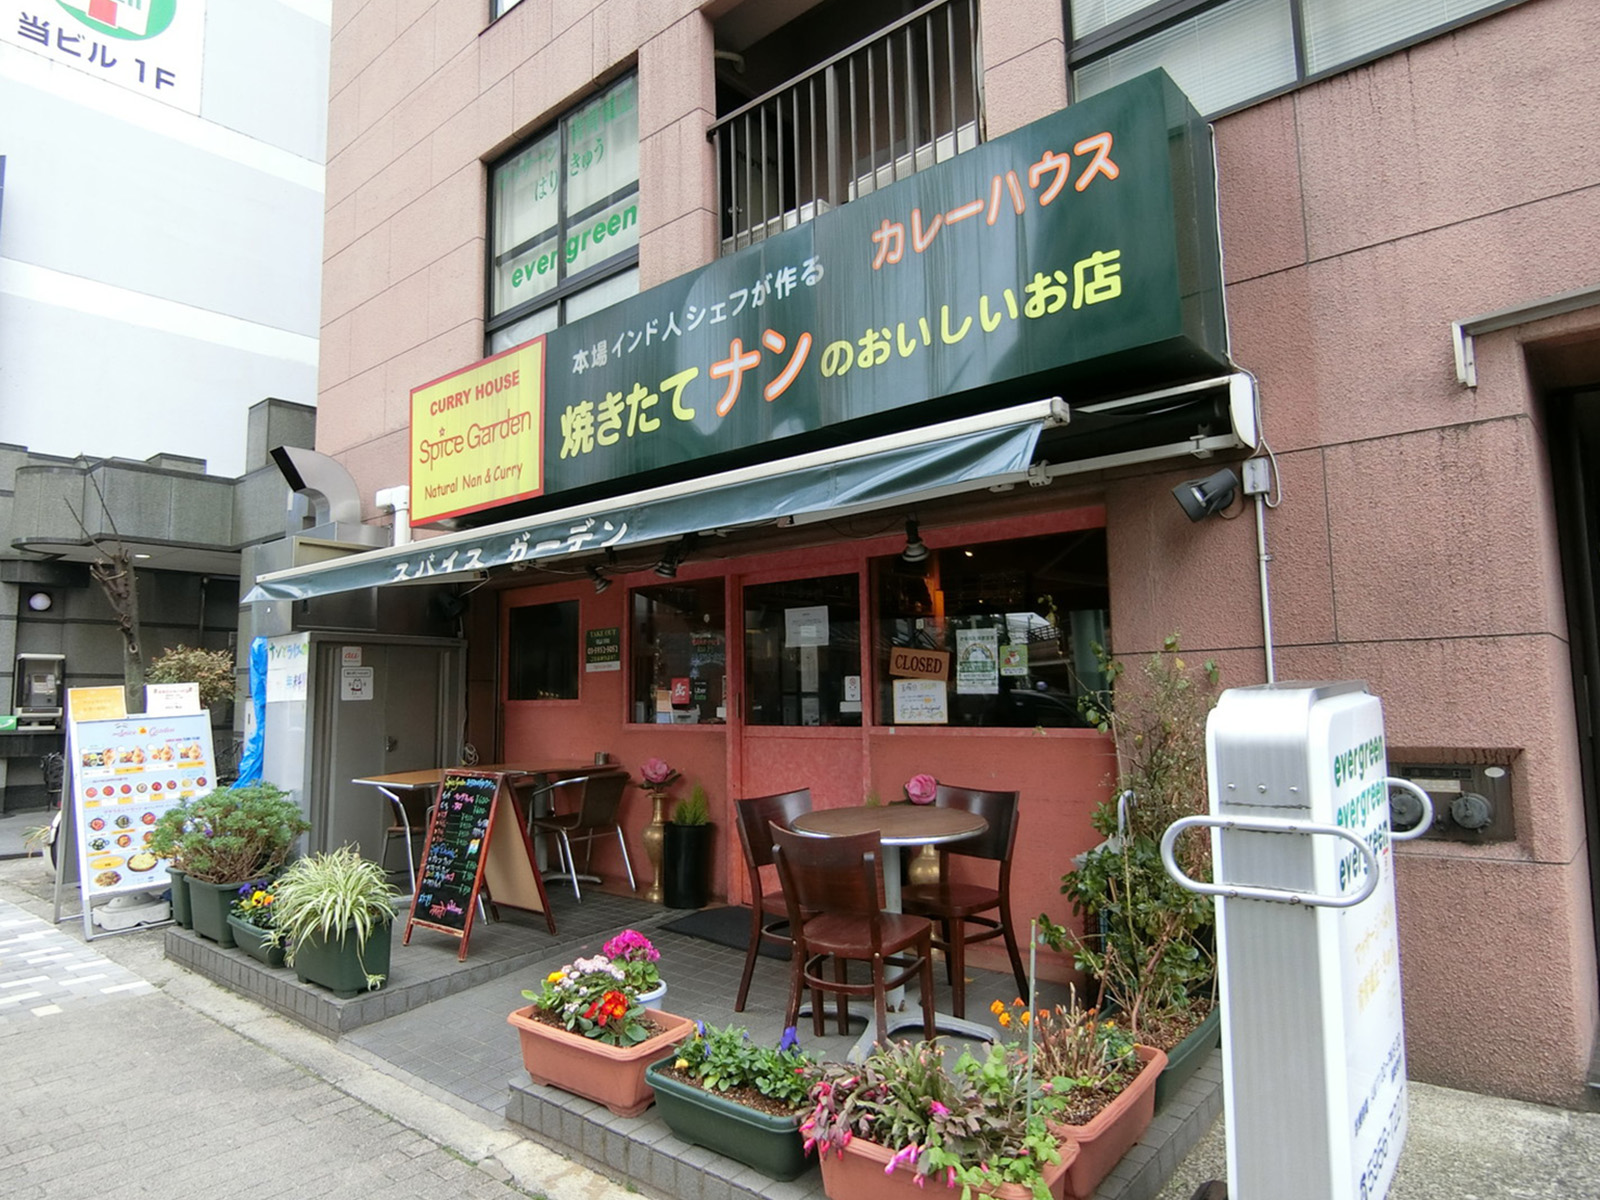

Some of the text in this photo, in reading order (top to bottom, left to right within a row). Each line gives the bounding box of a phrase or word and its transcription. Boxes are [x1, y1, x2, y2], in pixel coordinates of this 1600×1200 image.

[17, 11, 176, 90] 当ビル 1F
[533, 137, 605, 202] はり きゅう
[871, 130, 1120, 271] カレーハウス
[571, 254, 825, 375] 本場インド人シェフが作る
[430, 369, 520, 417] CURRY HOUSE
[419, 408, 532, 471] Spice Garden
[424, 462, 523, 500] Natural Nan & Curry
[392, 517, 628, 583] スパイス ガーデン
[894, 653, 943, 674] CLOSED
[1333, 735, 1384, 788] evergreen
